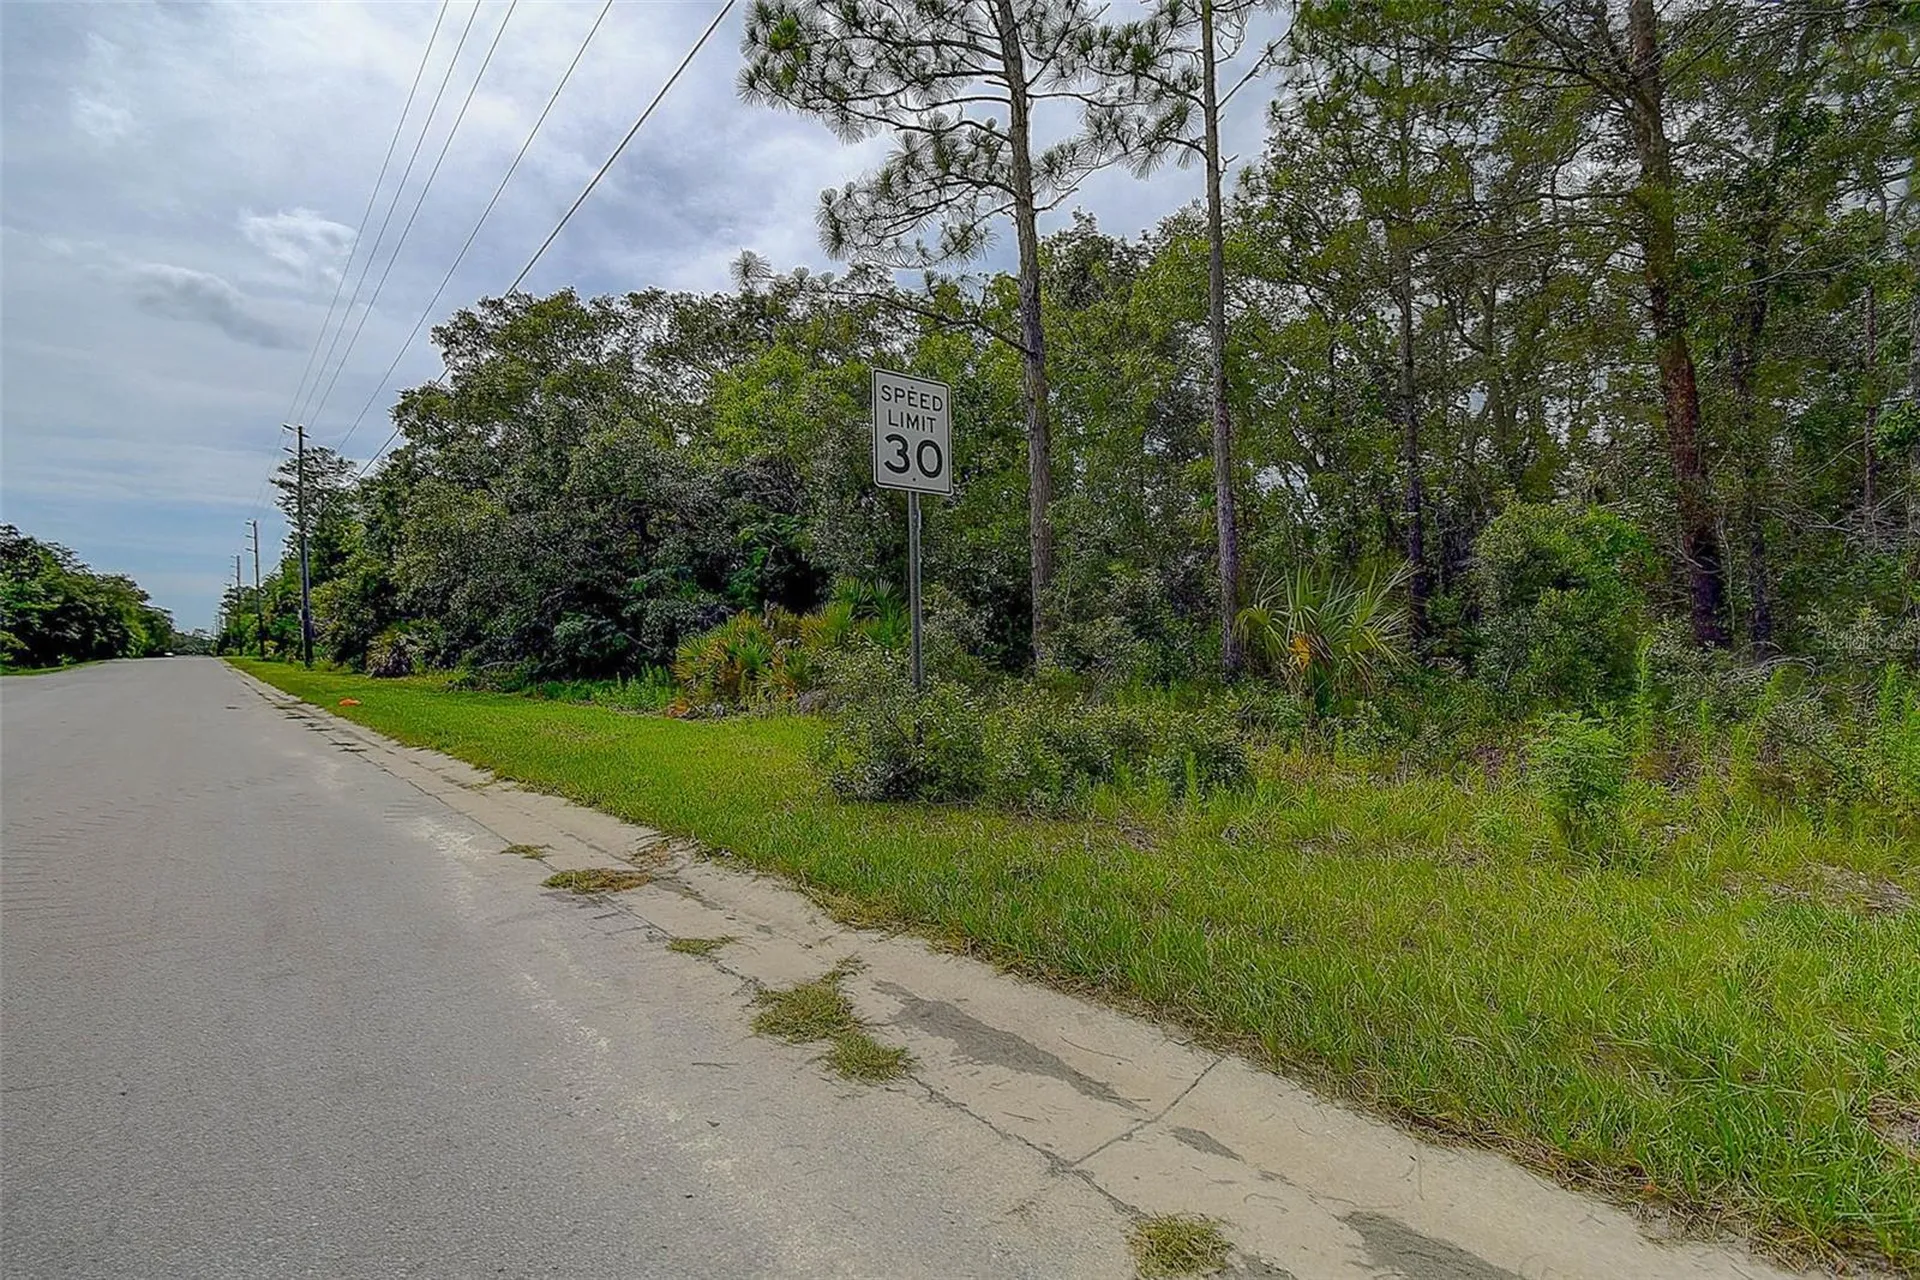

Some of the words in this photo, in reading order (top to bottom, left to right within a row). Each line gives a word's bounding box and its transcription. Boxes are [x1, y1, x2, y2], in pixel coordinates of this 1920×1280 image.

[881, 385, 943, 412] SPEED
[888, 409, 937, 433] LIMIT
[884, 433, 943, 479] 30
